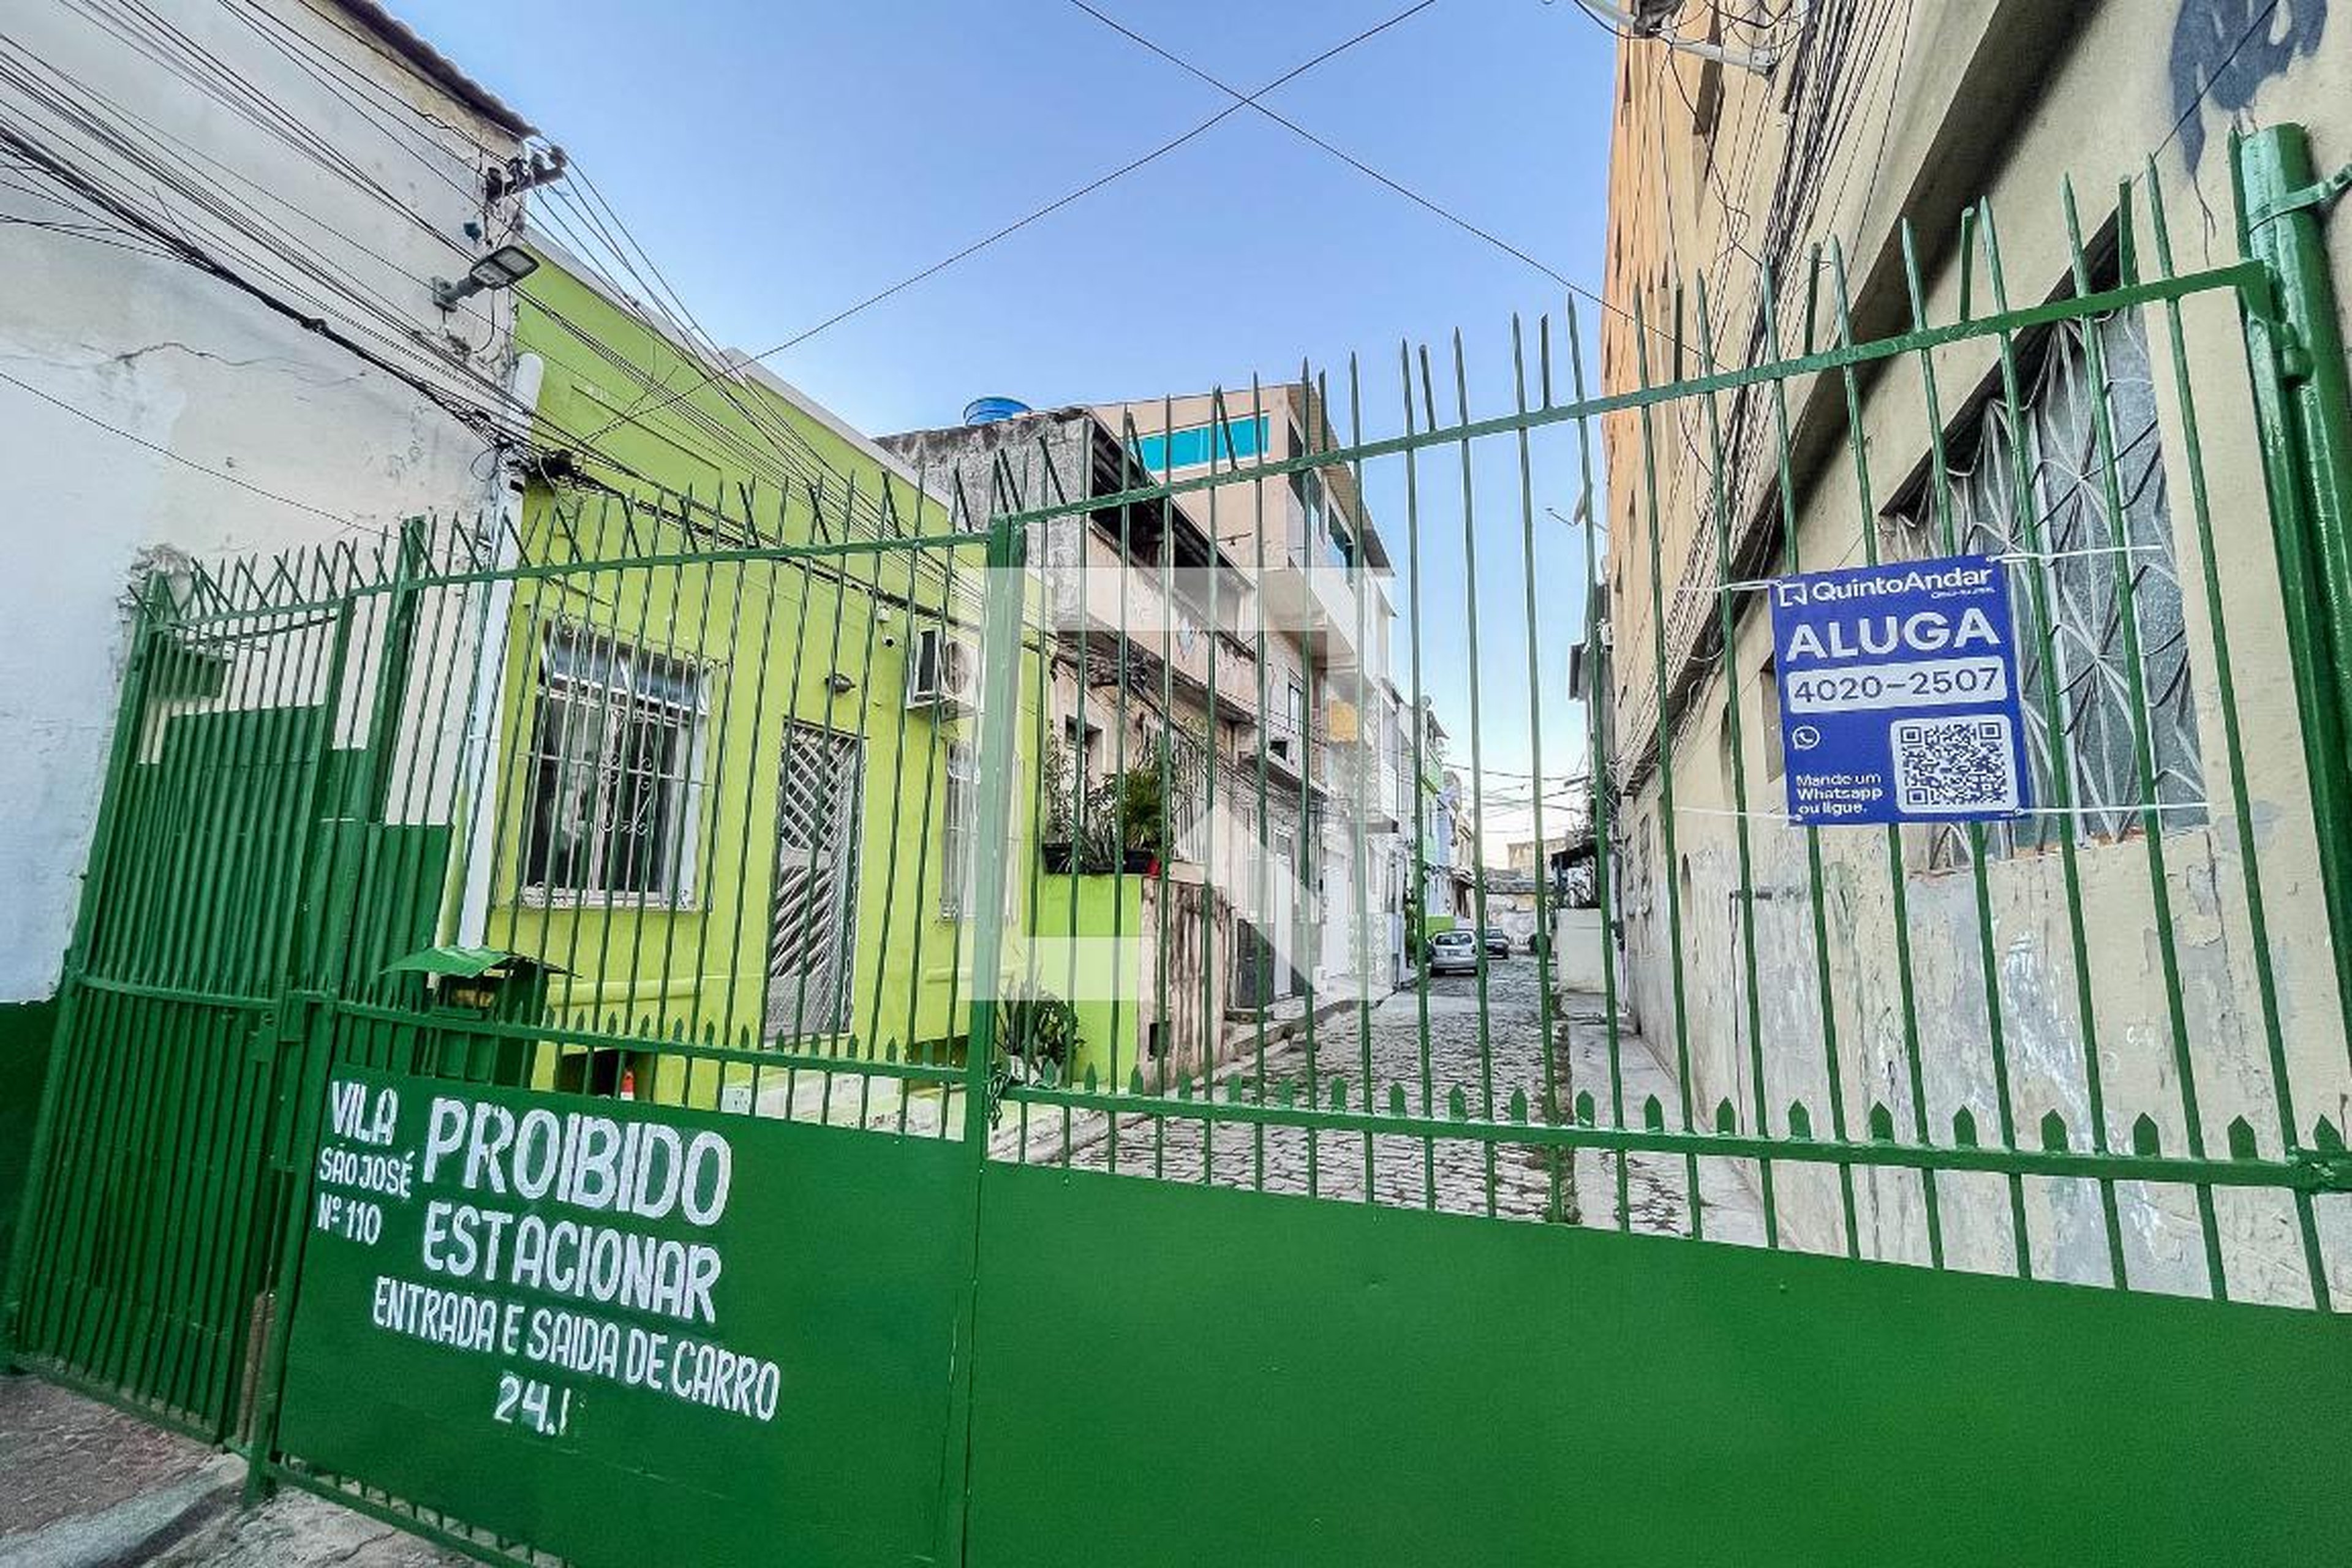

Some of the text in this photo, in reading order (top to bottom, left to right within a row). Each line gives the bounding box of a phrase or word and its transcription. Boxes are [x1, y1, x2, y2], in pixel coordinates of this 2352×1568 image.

[1812, 568, 1992, 601] QuintoAndar
[1785, 608, 2001, 662] ALUGA
[1794, 667, 1998, 703] 4020-2507
[1796, 773, 1882, 786] Mande um
[1796, 787, 1883, 801] Whatsapp
[1798, 801, 1868, 817] ou ligue.
[332, 1080, 398, 1146] VILA
[358, 1150, 415, 1199] JOSÉ
[422, 1098, 732, 1226] PROIBIDO
[345, 1200, 382, 1246] 110
[423, 1200, 722, 1324] ESTACIONAR
[372, 1276, 780, 1422] ENTRADA E SAIDA DE CARRO
